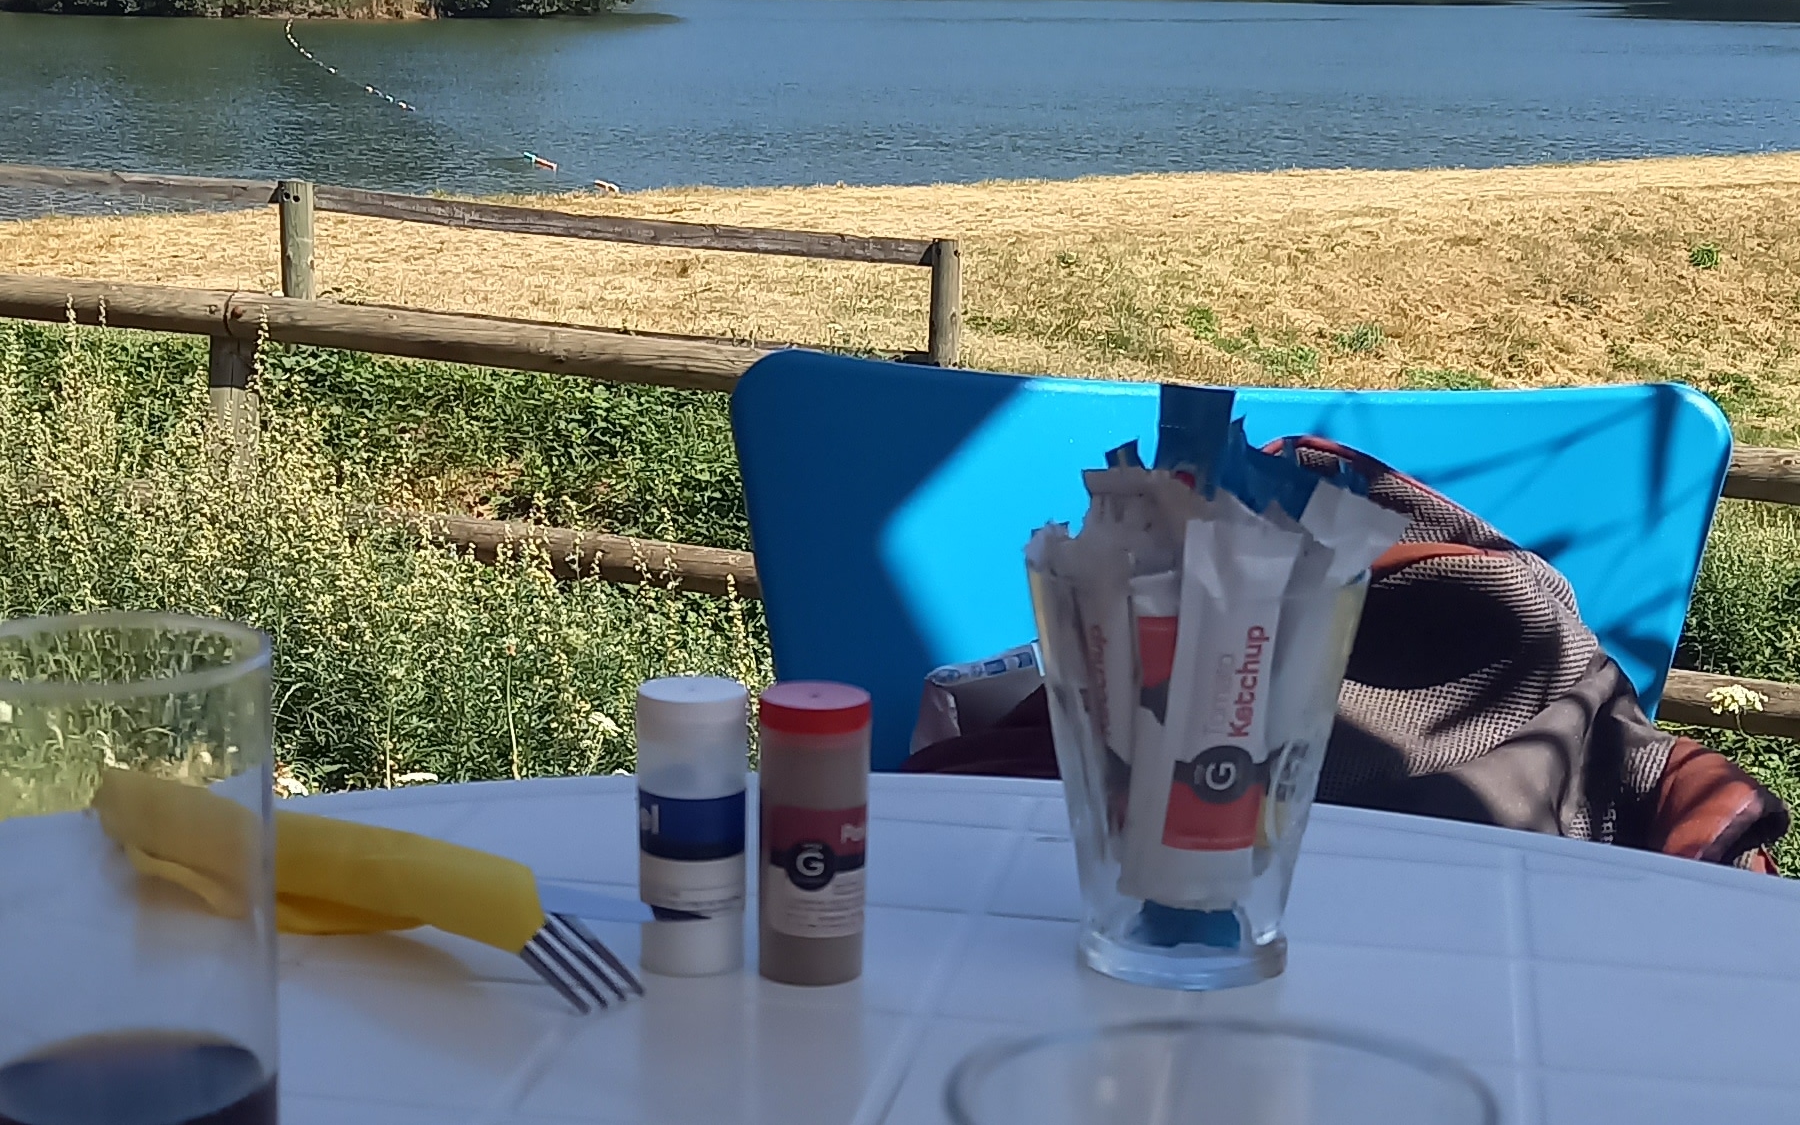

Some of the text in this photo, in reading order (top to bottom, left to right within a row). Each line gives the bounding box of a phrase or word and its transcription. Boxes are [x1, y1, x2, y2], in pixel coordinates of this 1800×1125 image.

[1227, 625, 1269, 737] Ketchup
[1206, 761, 1237, 791] G
[795, 850, 825, 876] G
